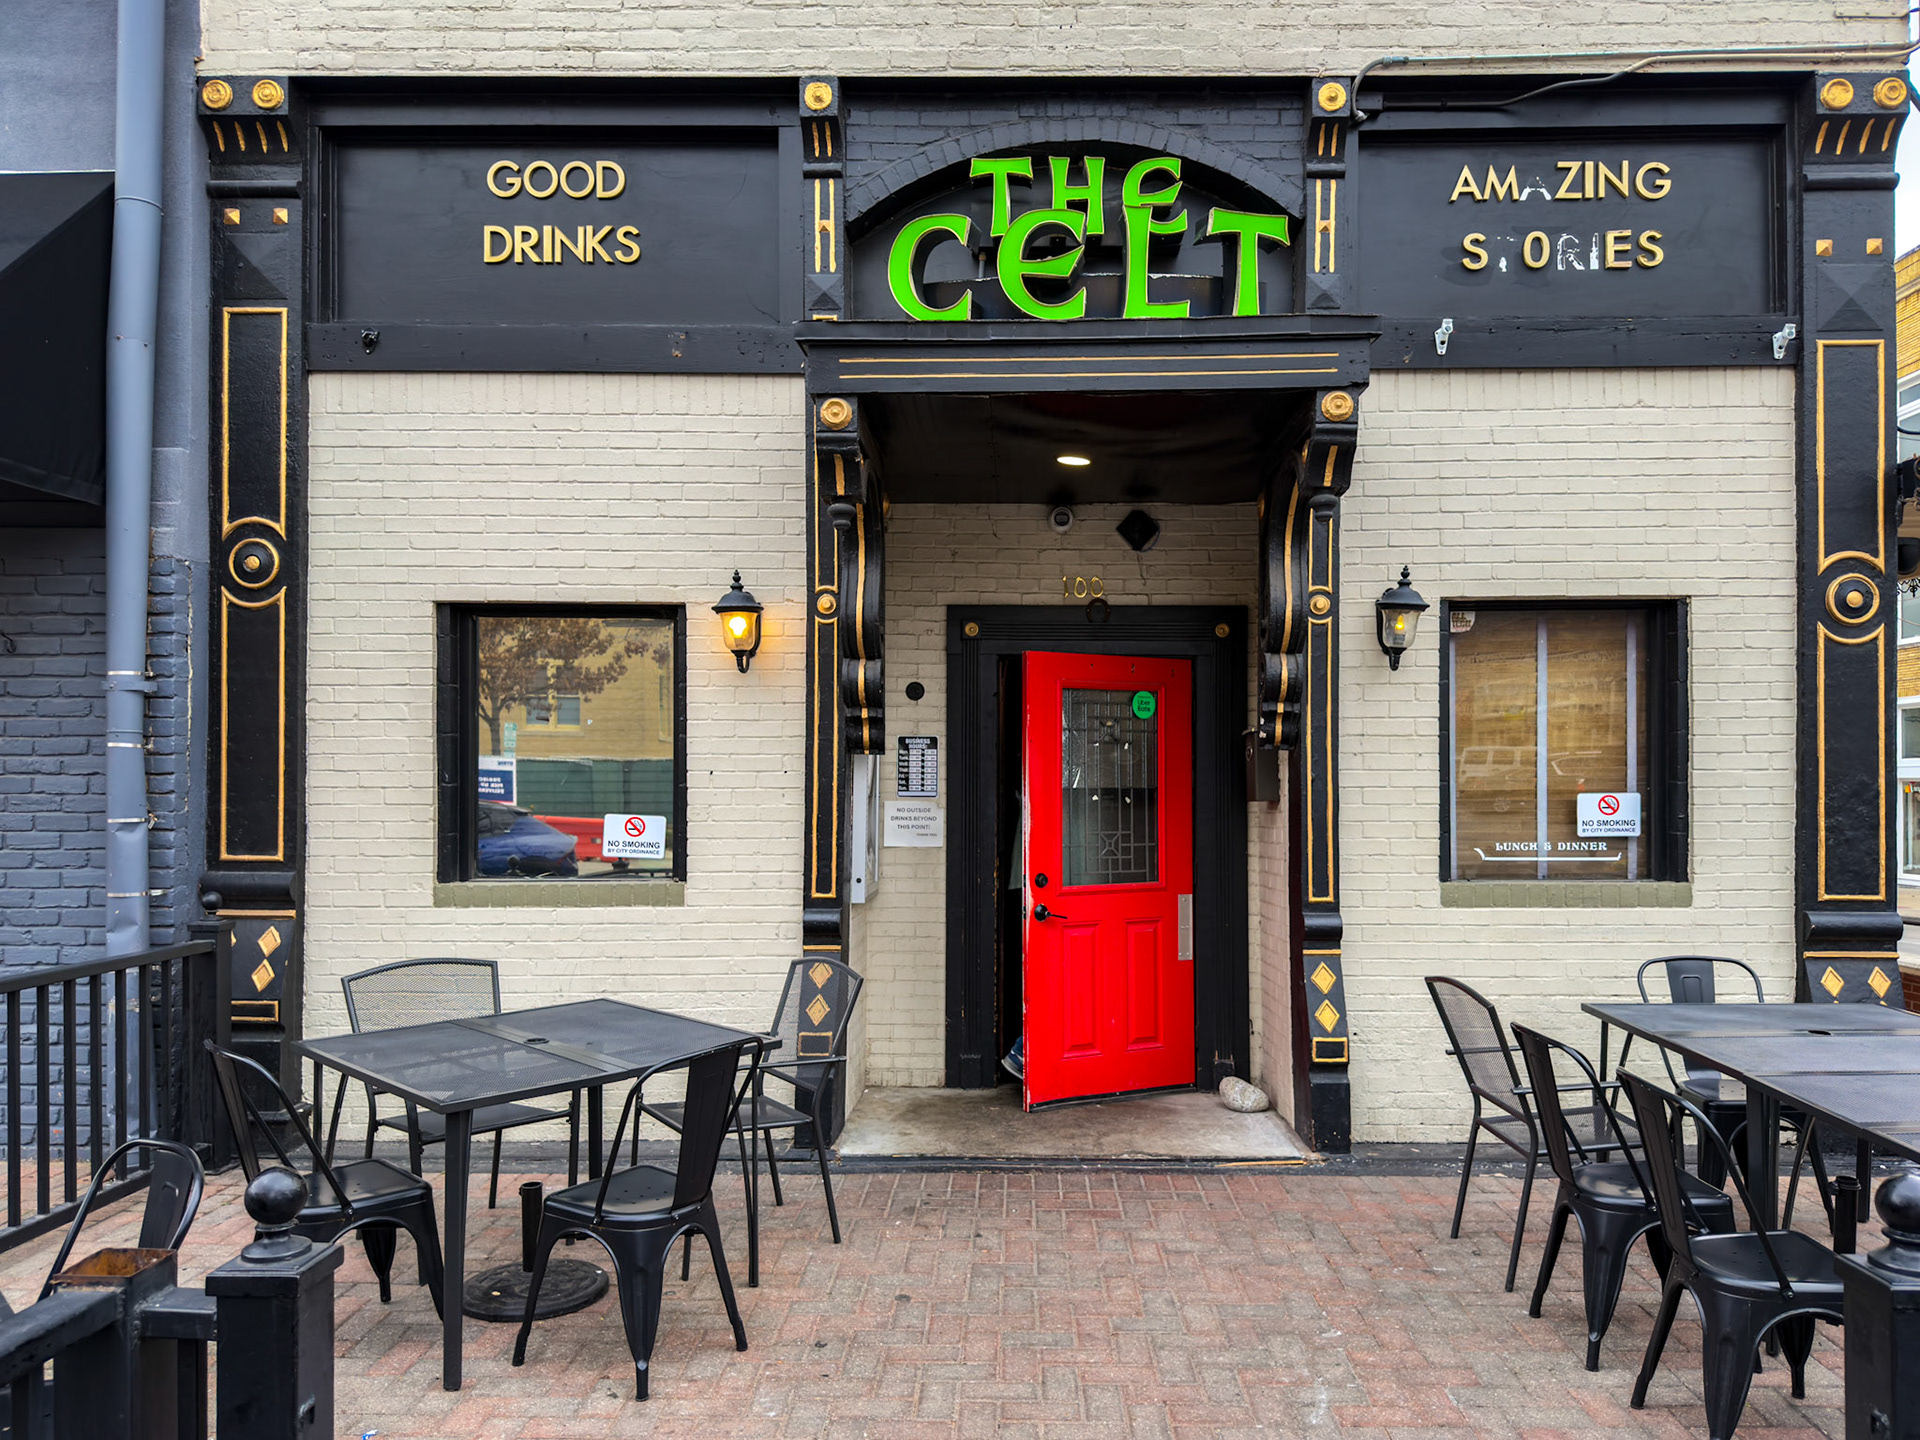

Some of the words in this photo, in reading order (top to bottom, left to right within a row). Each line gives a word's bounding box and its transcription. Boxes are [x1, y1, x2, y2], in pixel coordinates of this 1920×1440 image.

[486, 160, 626, 199] GOOD
[969, 156, 1188, 237] THE
[483, 224, 642, 264] DRINKS
[888, 205, 1290, 321] CELT
[1462, 230, 1665, 273] SORIES
[1062, 575, 1104, 598] 100
[608, 840, 620, 848] NO
[622, 840, 660, 849] SMOKING
[1543, 842, 1552, 851] &
[1557, 842, 1608, 851] DINNER
